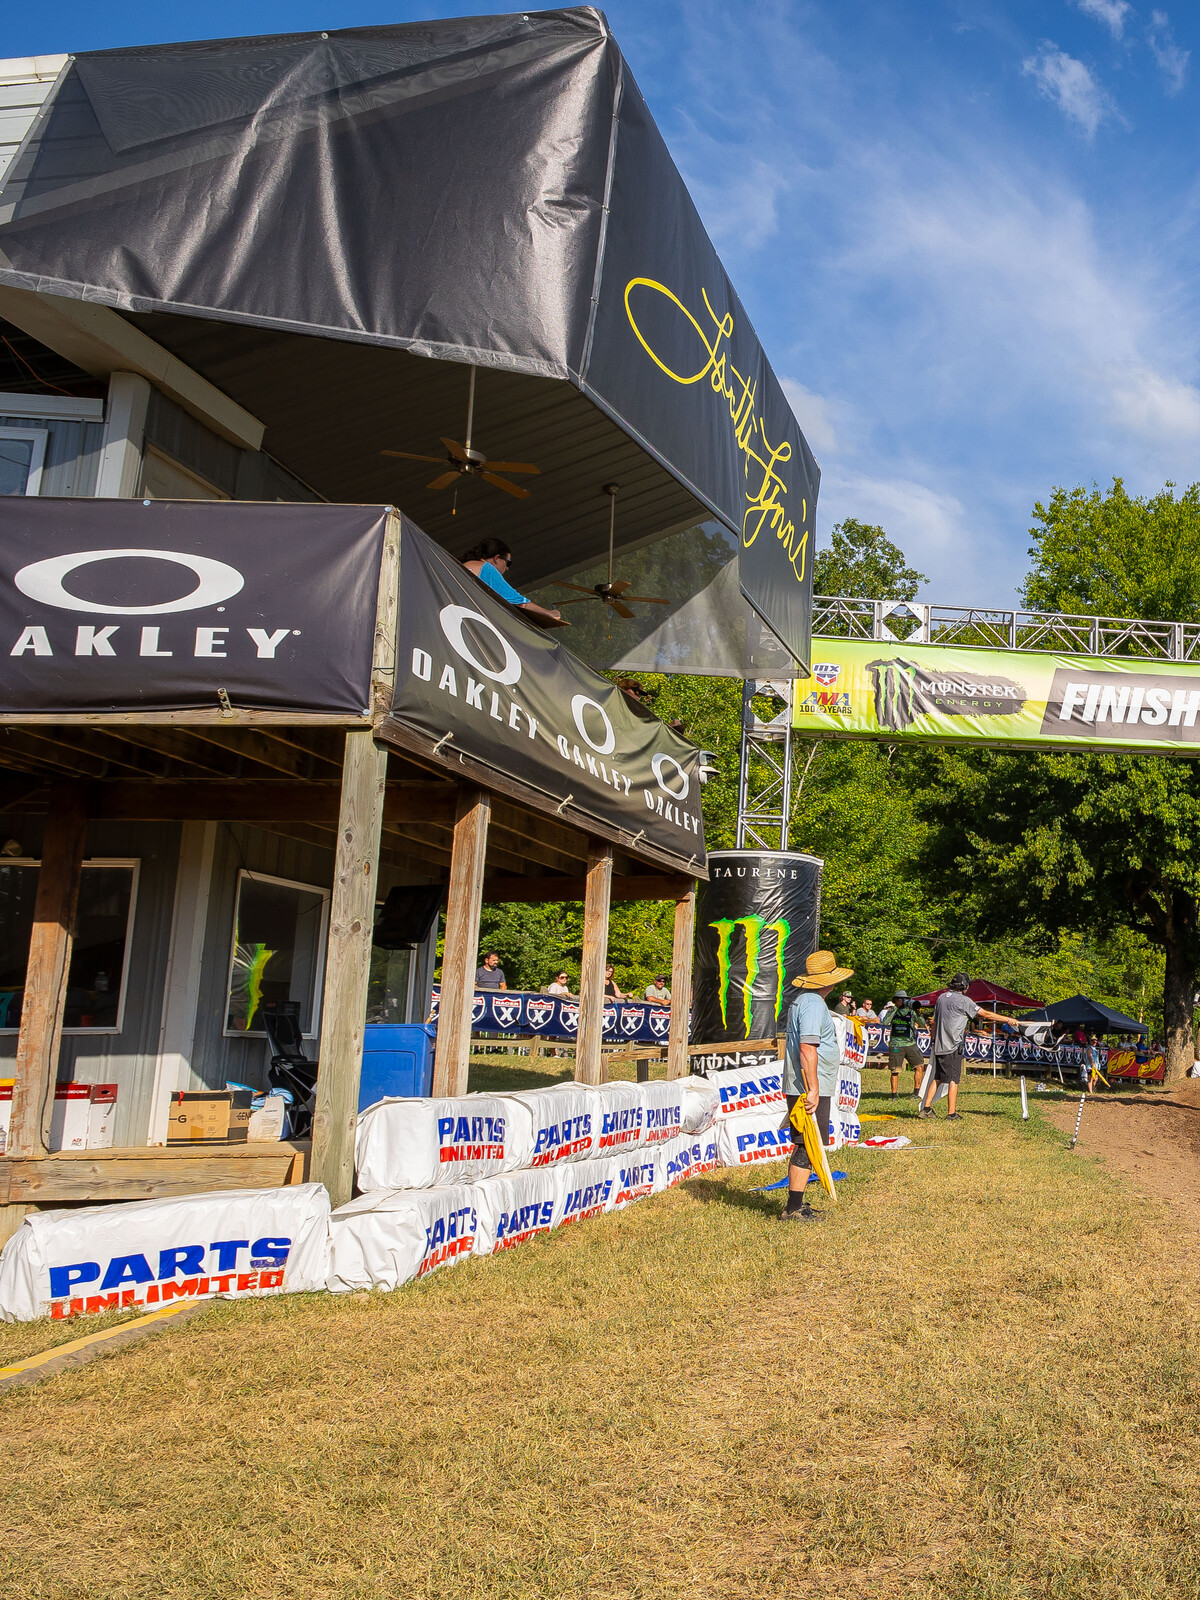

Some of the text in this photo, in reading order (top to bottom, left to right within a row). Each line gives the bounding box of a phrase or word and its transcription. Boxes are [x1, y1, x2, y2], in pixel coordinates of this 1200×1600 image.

[10, 625, 291, 659] AKLEY
[412, 647, 539, 740] OAKLEY
[800, 691, 850, 707] AMA
[920, 679, 1018, 699] MONSTER
[935, 698, 1004, 708] ENERGY
[827, 705, 852, 714] YEARS
[557, 734, 632, 797] OAKLEY
[643, 788, 699, 835] OAKLEY
[713, 866, 799, 880] TAURINE
[499, 1006, 515, 1021] X
[531, 1009, 547, 1024] X
[693, 1051, 778, 1075] MONST
[718, 1073, 784, 1103] PAR
[438, 1116, 507, 1145] PARTS
[533, 1114, 592, 1154] PARTS
[496, 1200, 555, 1238] PARTS
[49, 1236, 293, 1299] PARTS
[49, 1268, 286, 1320] UNLIMITED
